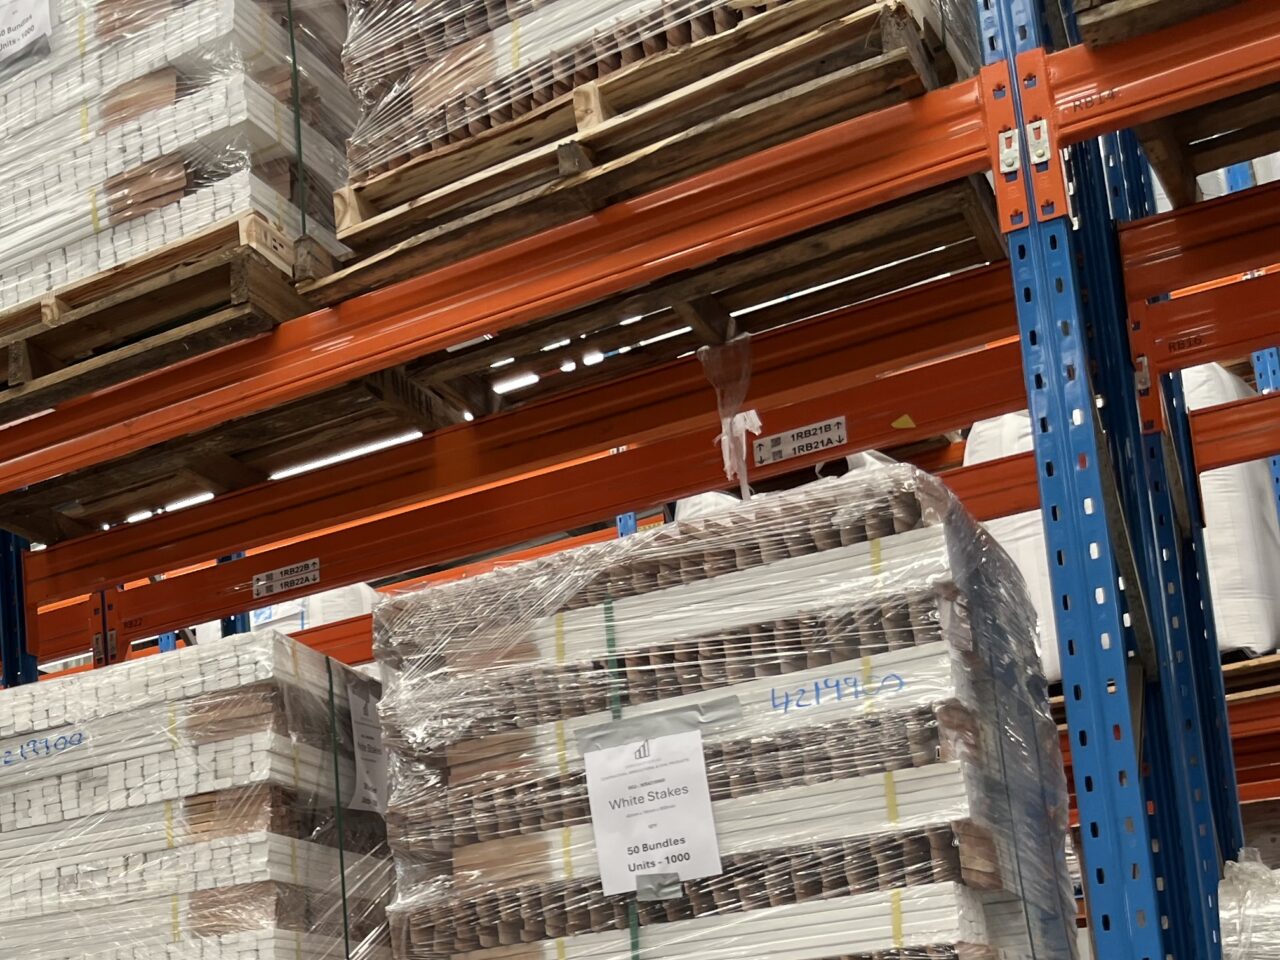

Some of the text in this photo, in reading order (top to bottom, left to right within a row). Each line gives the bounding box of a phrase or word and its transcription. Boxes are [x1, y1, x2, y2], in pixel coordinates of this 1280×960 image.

[790, 423, 832, 442] 1RB21B
[792, 437, 834, 456] 1RB21A
[280, 563, 310, 578] 1RB22B
[280, 576, 310, 590] 1RB22A
[608, 793, 645, 811] White
[647, 785, 689, 802] Stakes
[627, 836, 686, 856] 50 Bundles
[628, 859, 656, 872] Units
[664, 852, 691, 865] 1000
